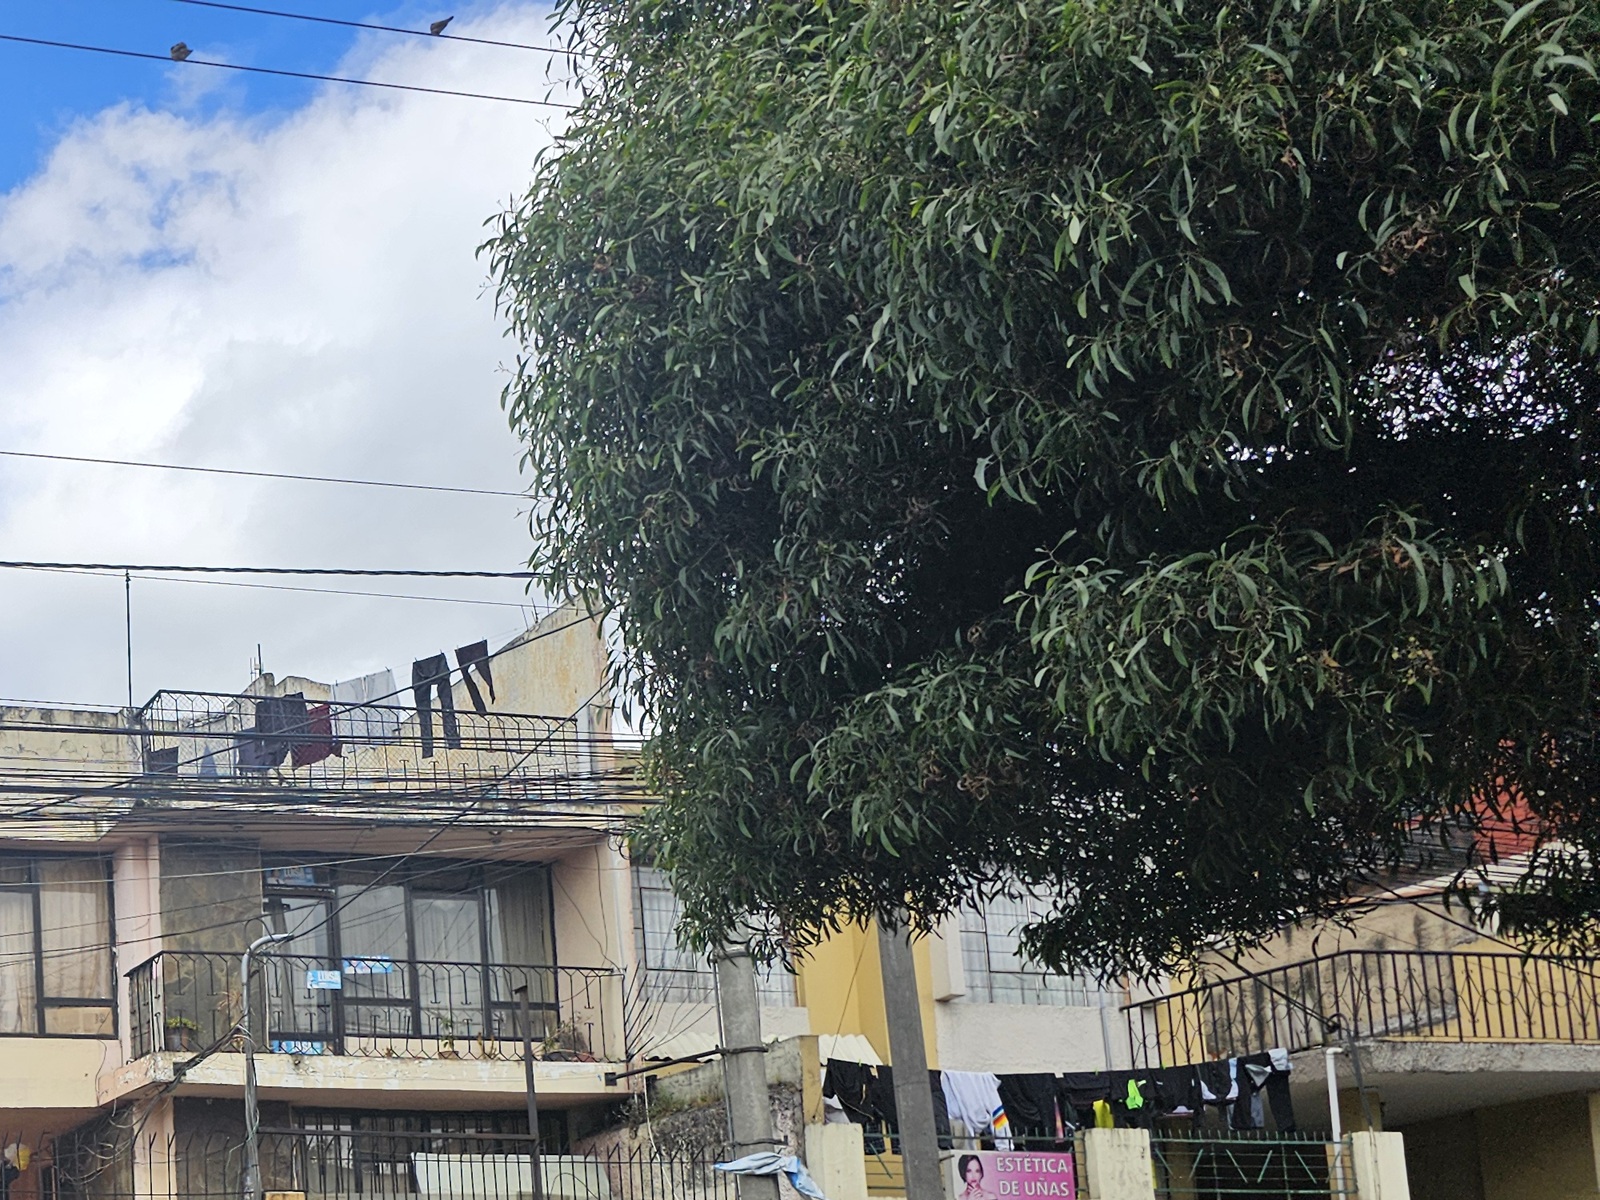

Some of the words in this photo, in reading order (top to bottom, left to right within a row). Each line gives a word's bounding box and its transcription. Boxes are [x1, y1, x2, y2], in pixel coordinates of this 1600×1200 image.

[996, 1154, 1069, 1174] ESTÉTICA
[999, 1180, 1020, 1196] DE
[1024, 1177, 1070, 1197] UÑAS
